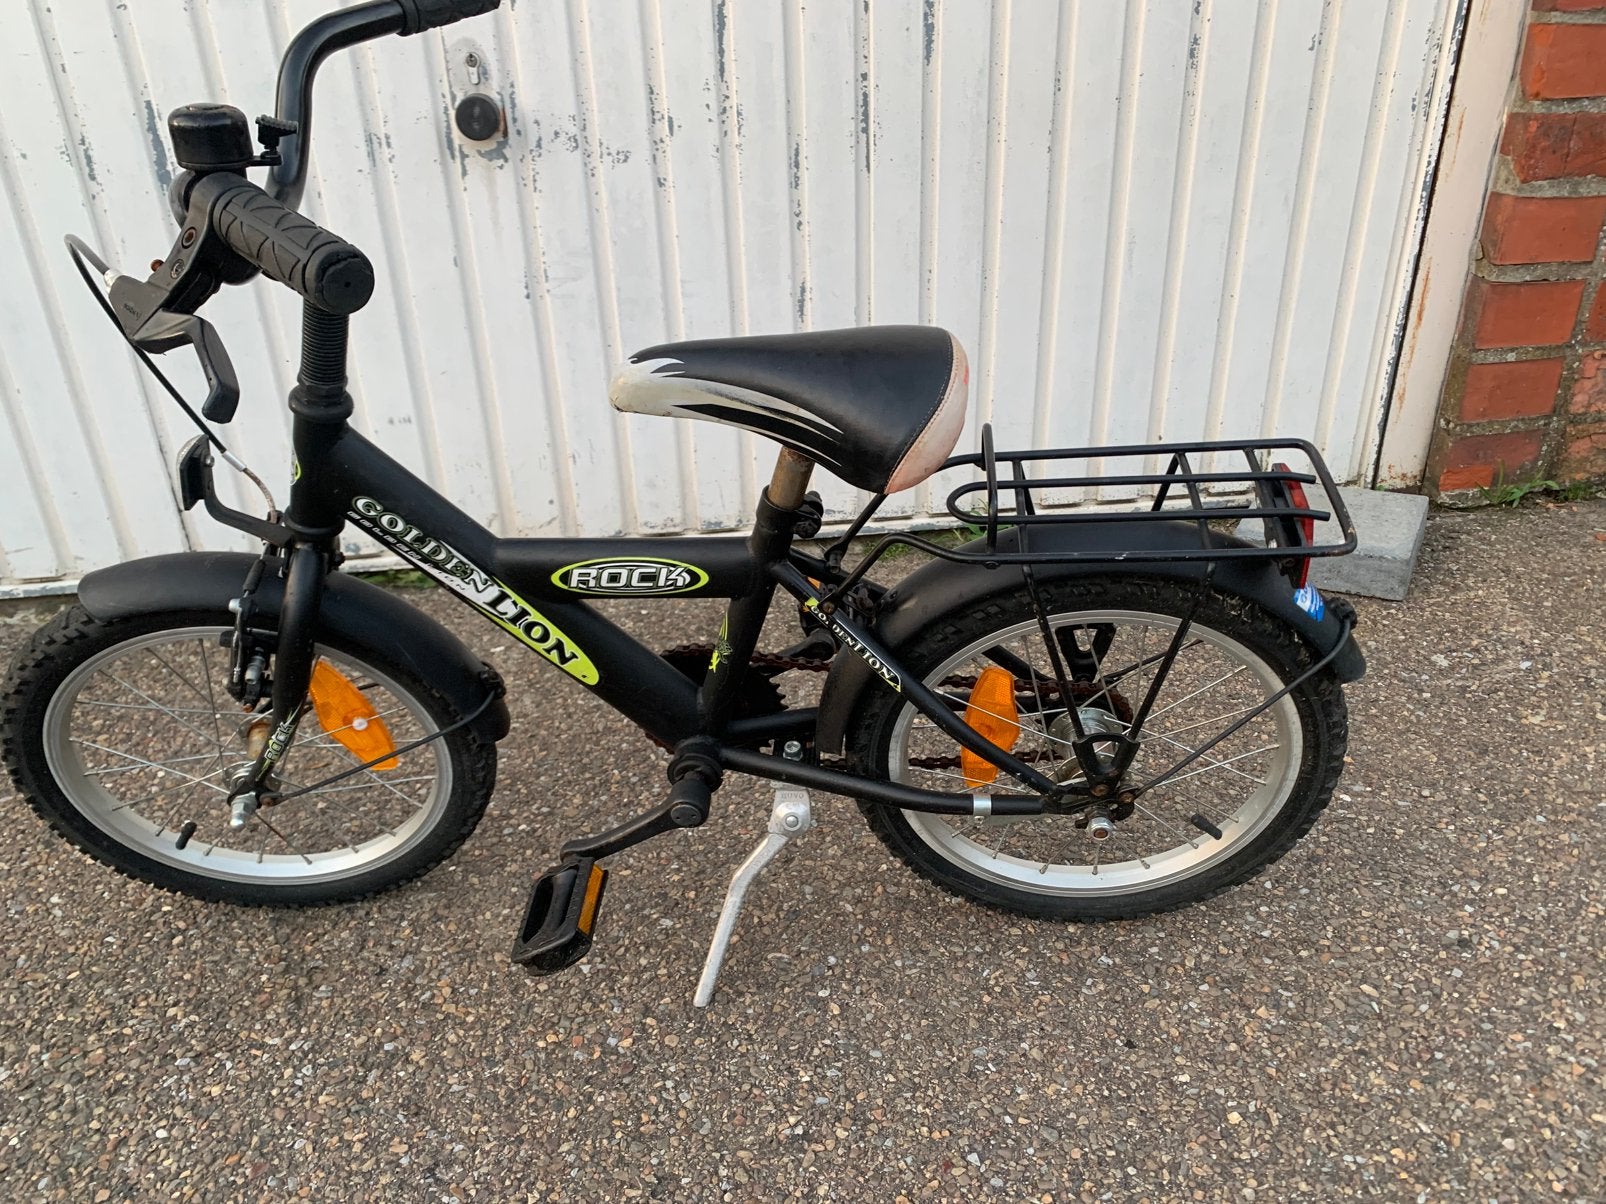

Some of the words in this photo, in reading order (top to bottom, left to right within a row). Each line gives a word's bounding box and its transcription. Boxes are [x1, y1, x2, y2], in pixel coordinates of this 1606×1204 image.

[352, 496, 495, 593] GOLDEN
[484, 588, 579, 666] LION
[568, 566, 688, 588] ROCK
[264, 721, 295, 761] ROCK
